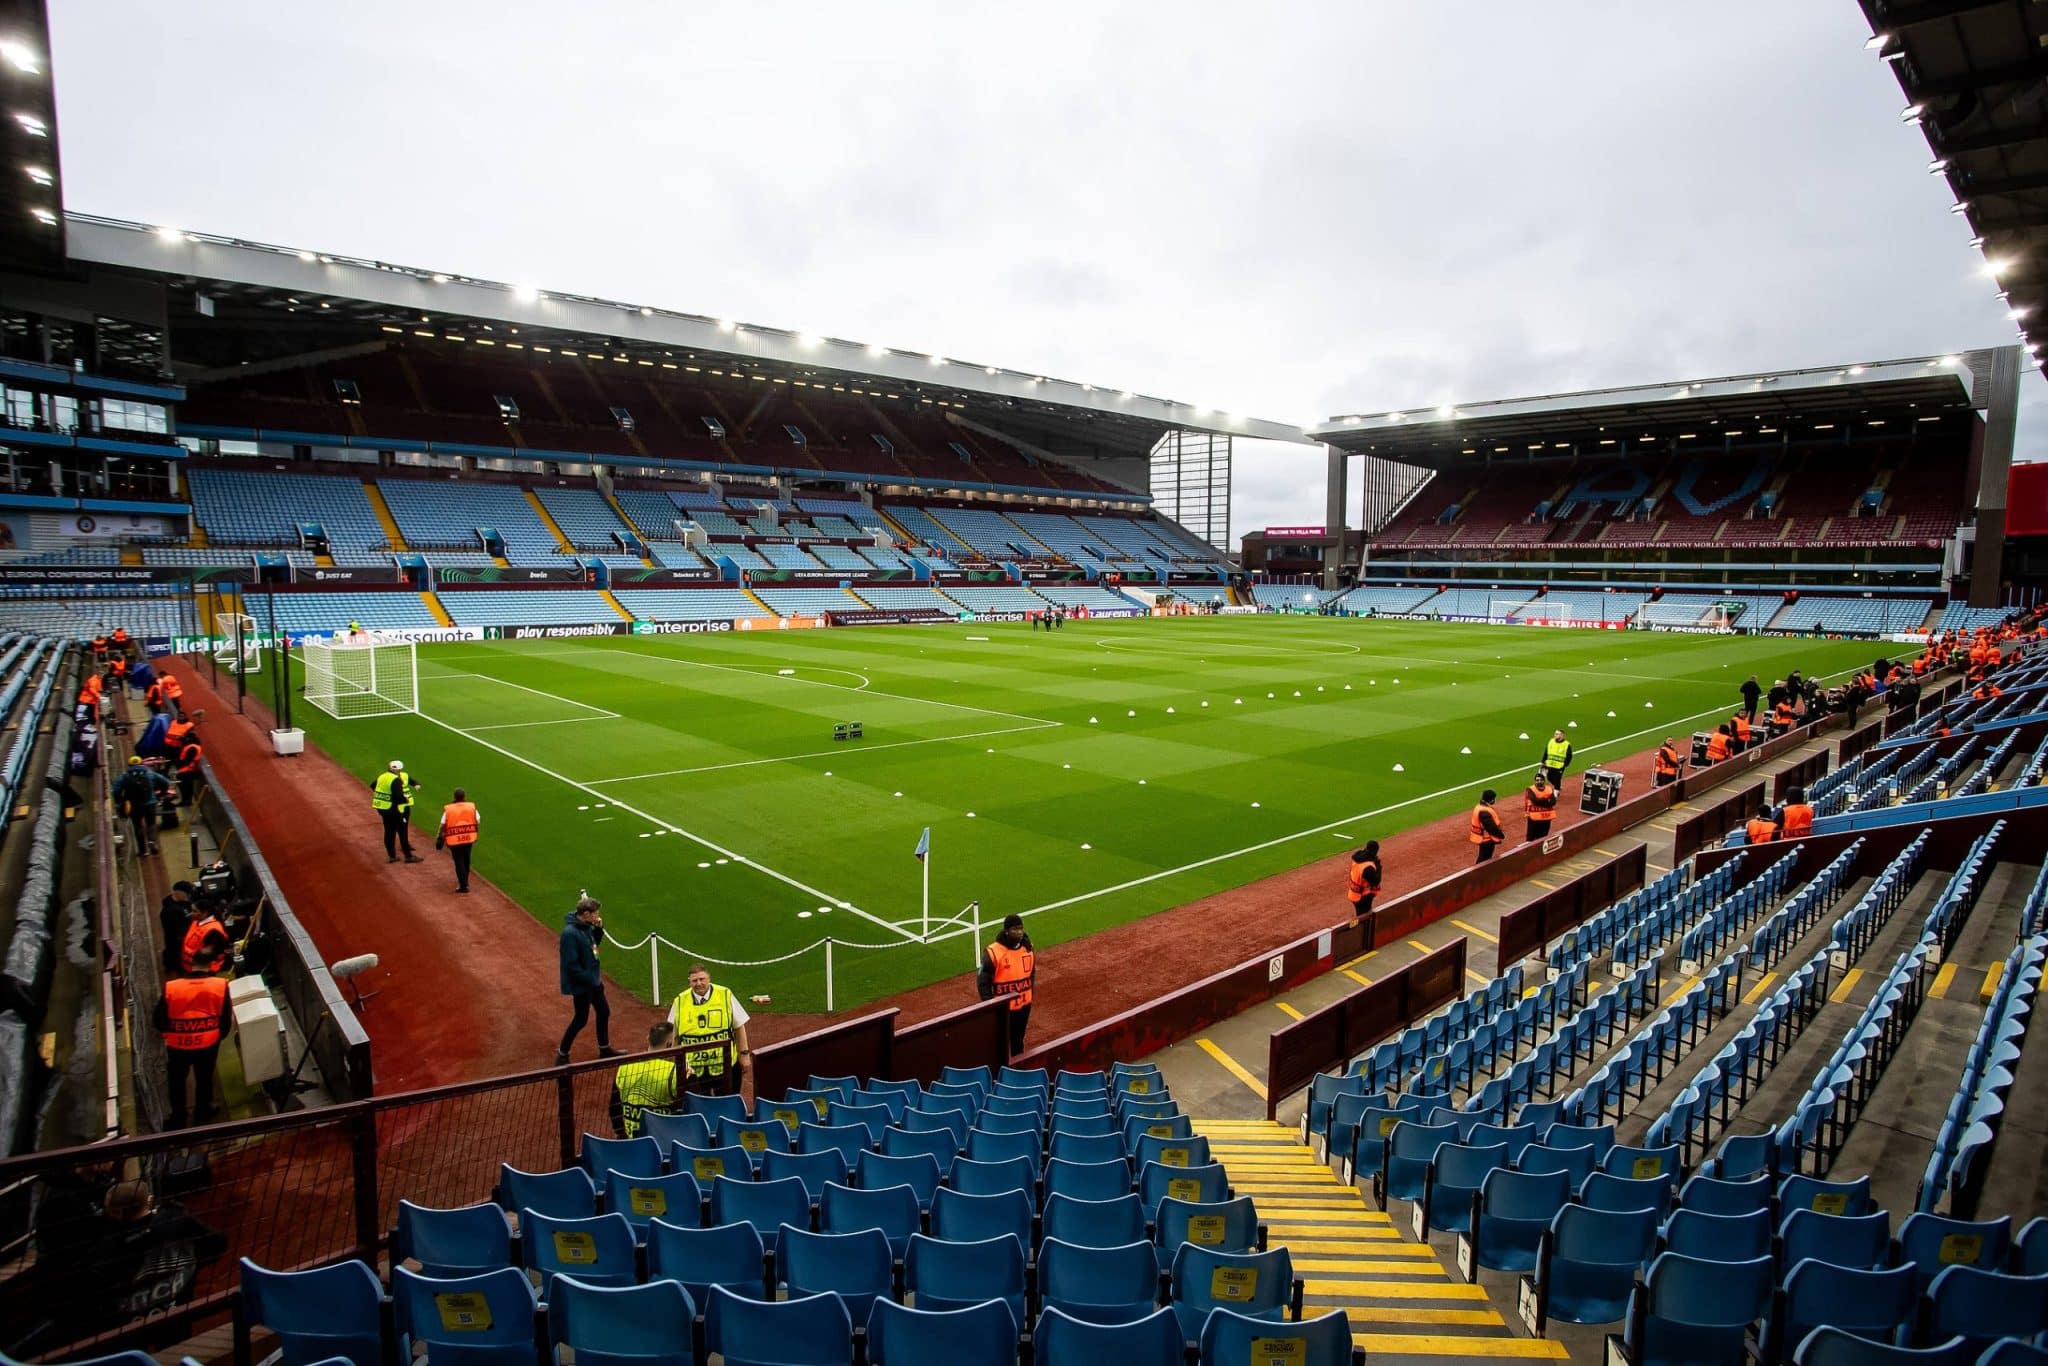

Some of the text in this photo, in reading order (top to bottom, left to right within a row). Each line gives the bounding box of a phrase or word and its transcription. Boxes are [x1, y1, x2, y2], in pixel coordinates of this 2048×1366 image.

[529, 571, 548, 579] bwin
[964, 611, 1024, 622] enterprise
[1372, 612, 1428, 621] nterprise
[516, 623, 616, 639] play responsibly
[640, 620, 730, 635] enterprise
[997, 979, 1031, 994] STEWA
[694, 1051, 717, 1062] 294
